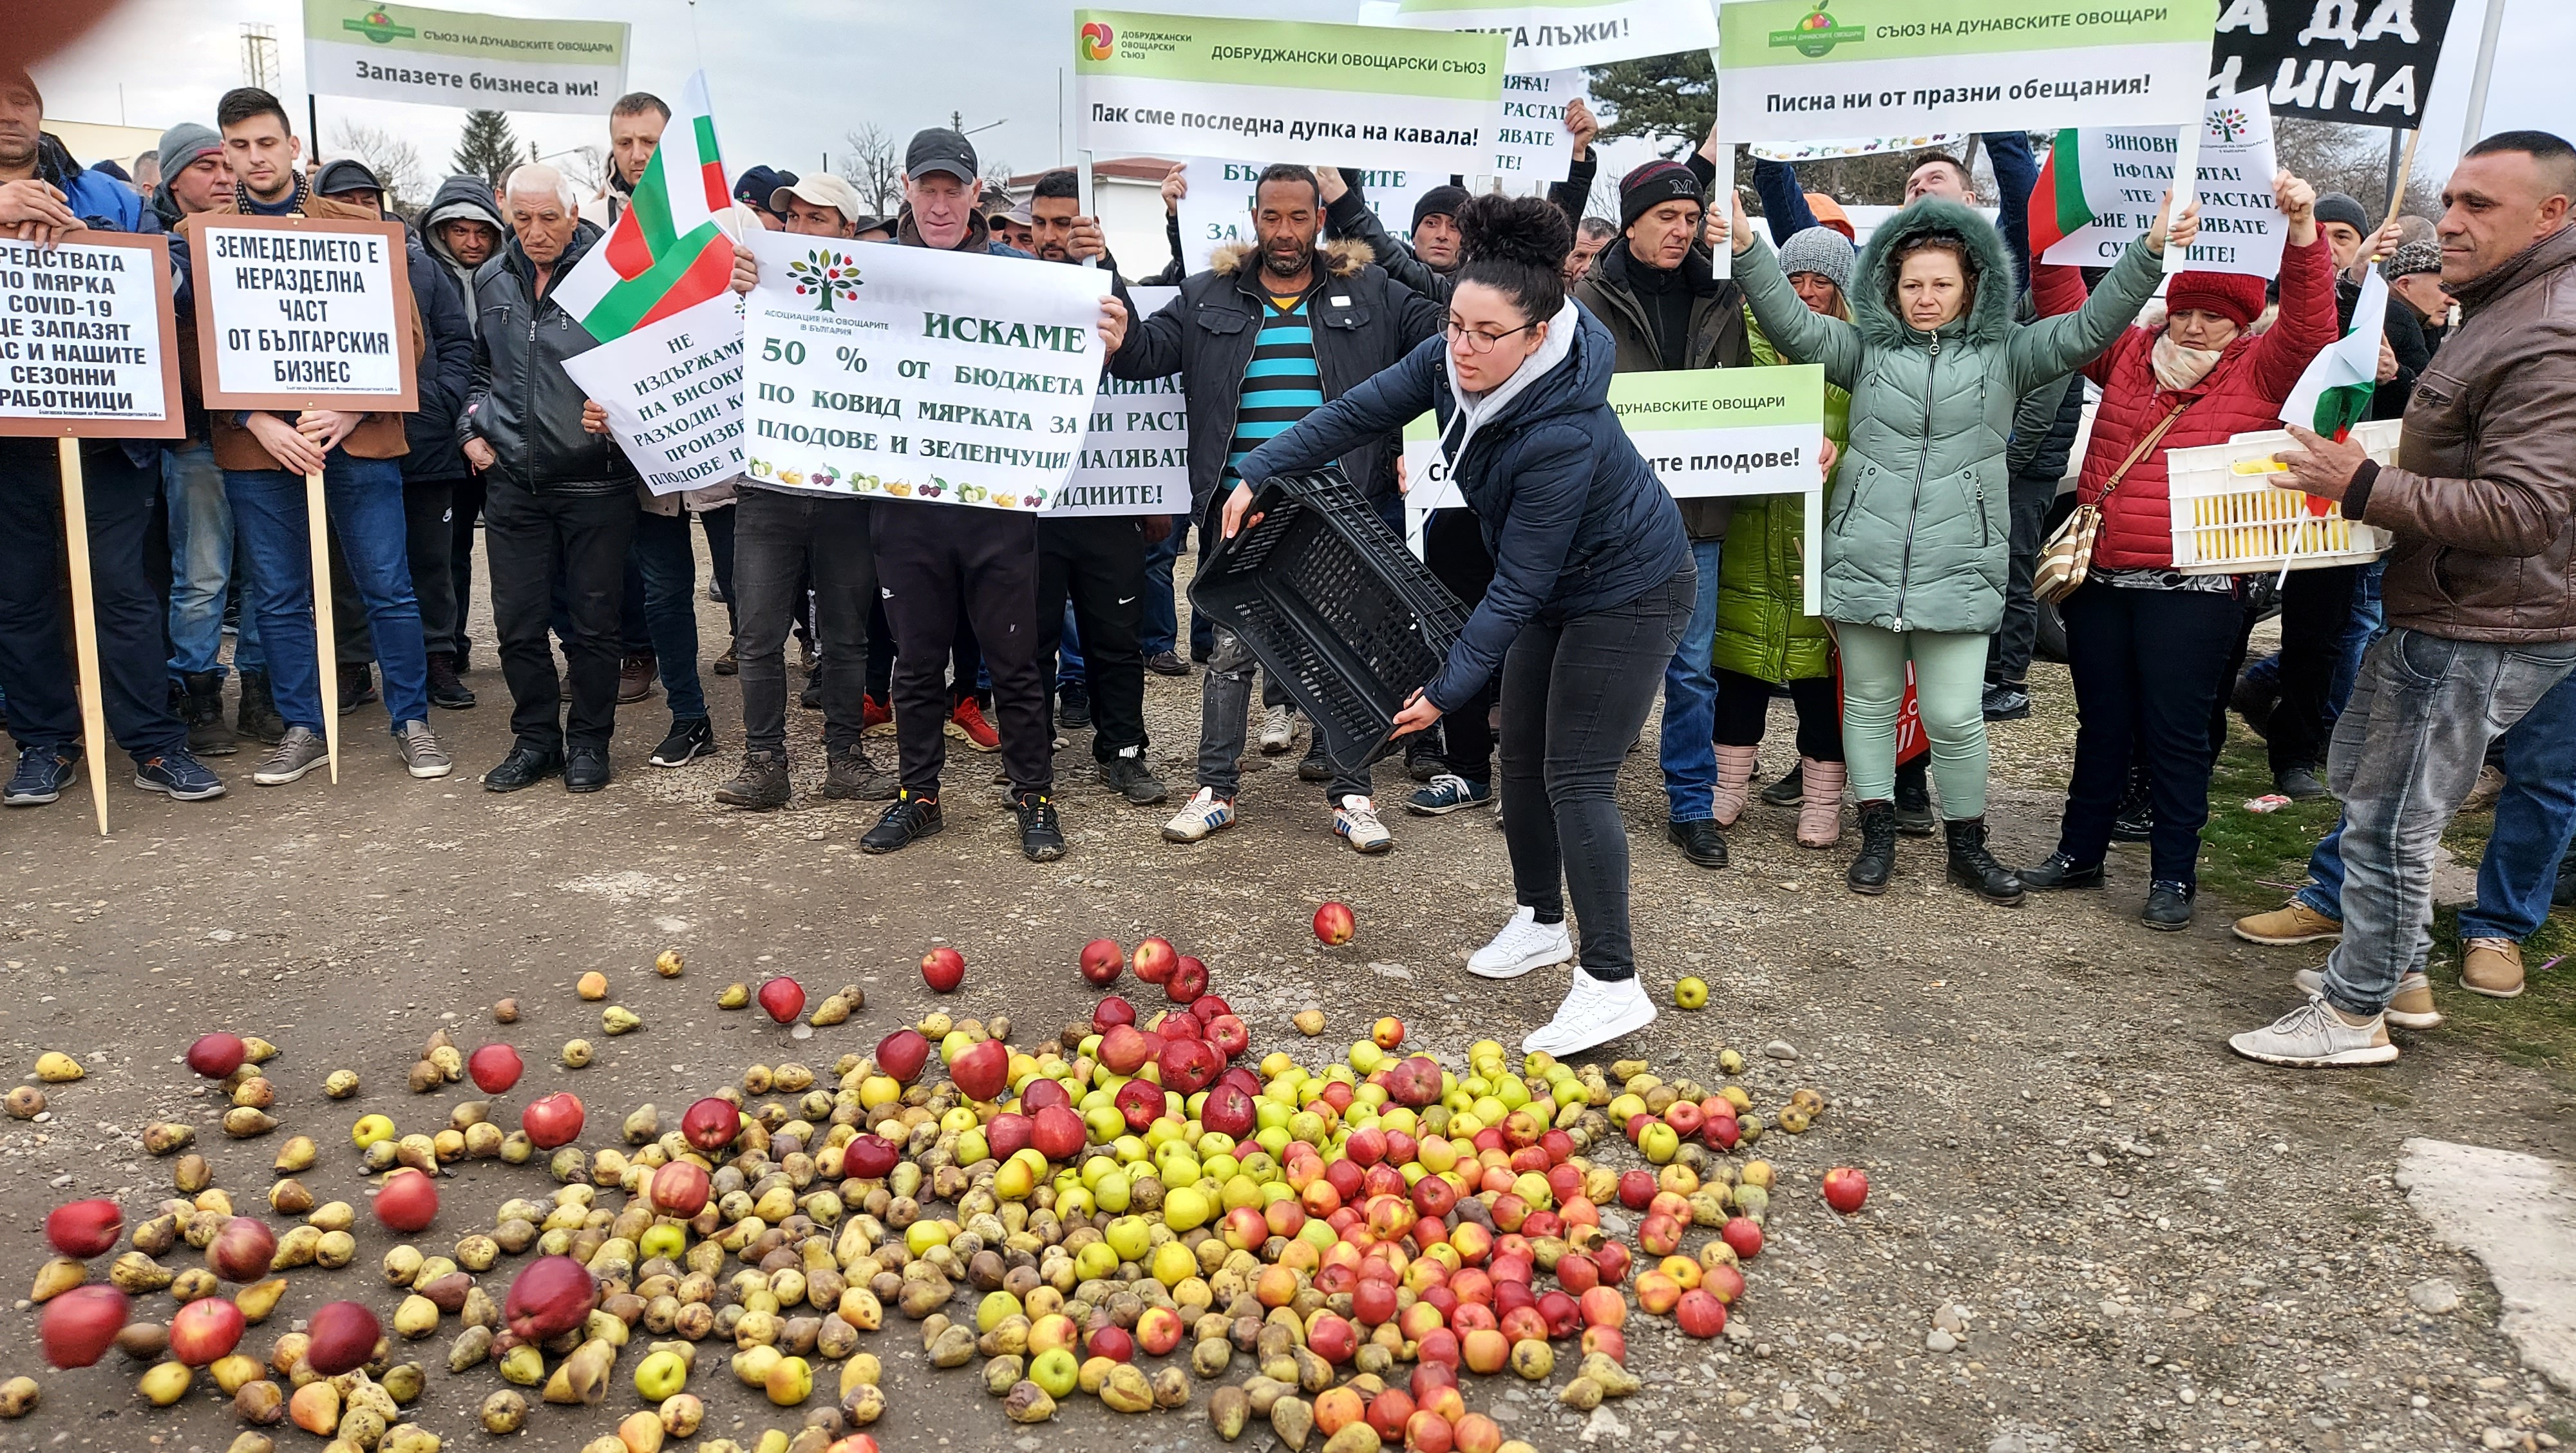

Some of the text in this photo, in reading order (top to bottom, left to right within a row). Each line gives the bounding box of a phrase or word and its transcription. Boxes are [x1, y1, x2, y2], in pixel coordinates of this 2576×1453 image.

[1876, 8, 2168, 39] СЪЮЗ НА ДУНАВСКИТЕ ОВОЩАРИ
[423, 30, 614, 53] СЪЮЗ НА ДУНАВСКИТЕ ОВОЩАРИ
[1121, 31, 1192, 43] ДОБРУДЖАНСКИ
[1121, 41, 1175, 52] ОВОЩАРСКИ
[1121, 51, 1146, 59] СЪЮЗ
[1211, 46, 1486, 75] ДОБРУДЖАНСКИ ОВОЩАРСКИ СЪЮЗ
[355, 61, 600, 97] Запазете бизнеса ни!
[2269, 57, 2416, 117] ИМА
[1766, 74, 2151, 113] Писна ни от празни обещания!
[1092, 102, 1479, 146] Пак сме последна дупка на кавала!
[216, 236, 379, 263] ЗЕМЕДЕЛИЕТО Е
[32, 273, 116, 294] МЯРКА
[236, 267, 366, 294] НЕРАЗДЕЛНА
[8, 294, 112, 318] COVID-19
[279, 299, 327, 322] ЧАСТ
[32, 319, 131, 341] ЗАПАЗЯТ
[764, 309, 820, 323] АСОЦИАЦИЯ
[835, 318, 889, 330] ОВОЩАРИТЕ
[809, 325, 851, 336] БЪЛГАРИЯ
[228, 328, 390, 355] ОТ БЪЛГАРСКИЯ
[666, 333, 694, 354] НЕ
[921, 310, 1087, 354] ИСКАМЕ
[28, 343, 44, 361] И
[52, 344, 146, 365] НАШИТЕ
[761, 336, 1084, 396] 50 % ОТ БЮДЖЕТА
[11, 366, 116, 386] СЕЗОННИ
[274, 360, 350, 383] БИЗНЕС
[0, 389, 133, 411] РАБОТНИЦИ
[638, 401, 668, 422] НА
[758, 381, 1077, 434] ПО КОВИД МЯРКАТА ЗА
[1615, 395, 1785, 416] ДУНАВСКИТЕ ОВОЩАРИ
[632, 403, 721, 448] РАЗХОДИ!
[757, 418, 1070, 473] ПЛОДОВЕ И ЗЕЛЕНЧУЦИ!
[649, 456, 724, 486] ПЛОДОВЕ
[1690, 447, 1800, 473] плодове!
